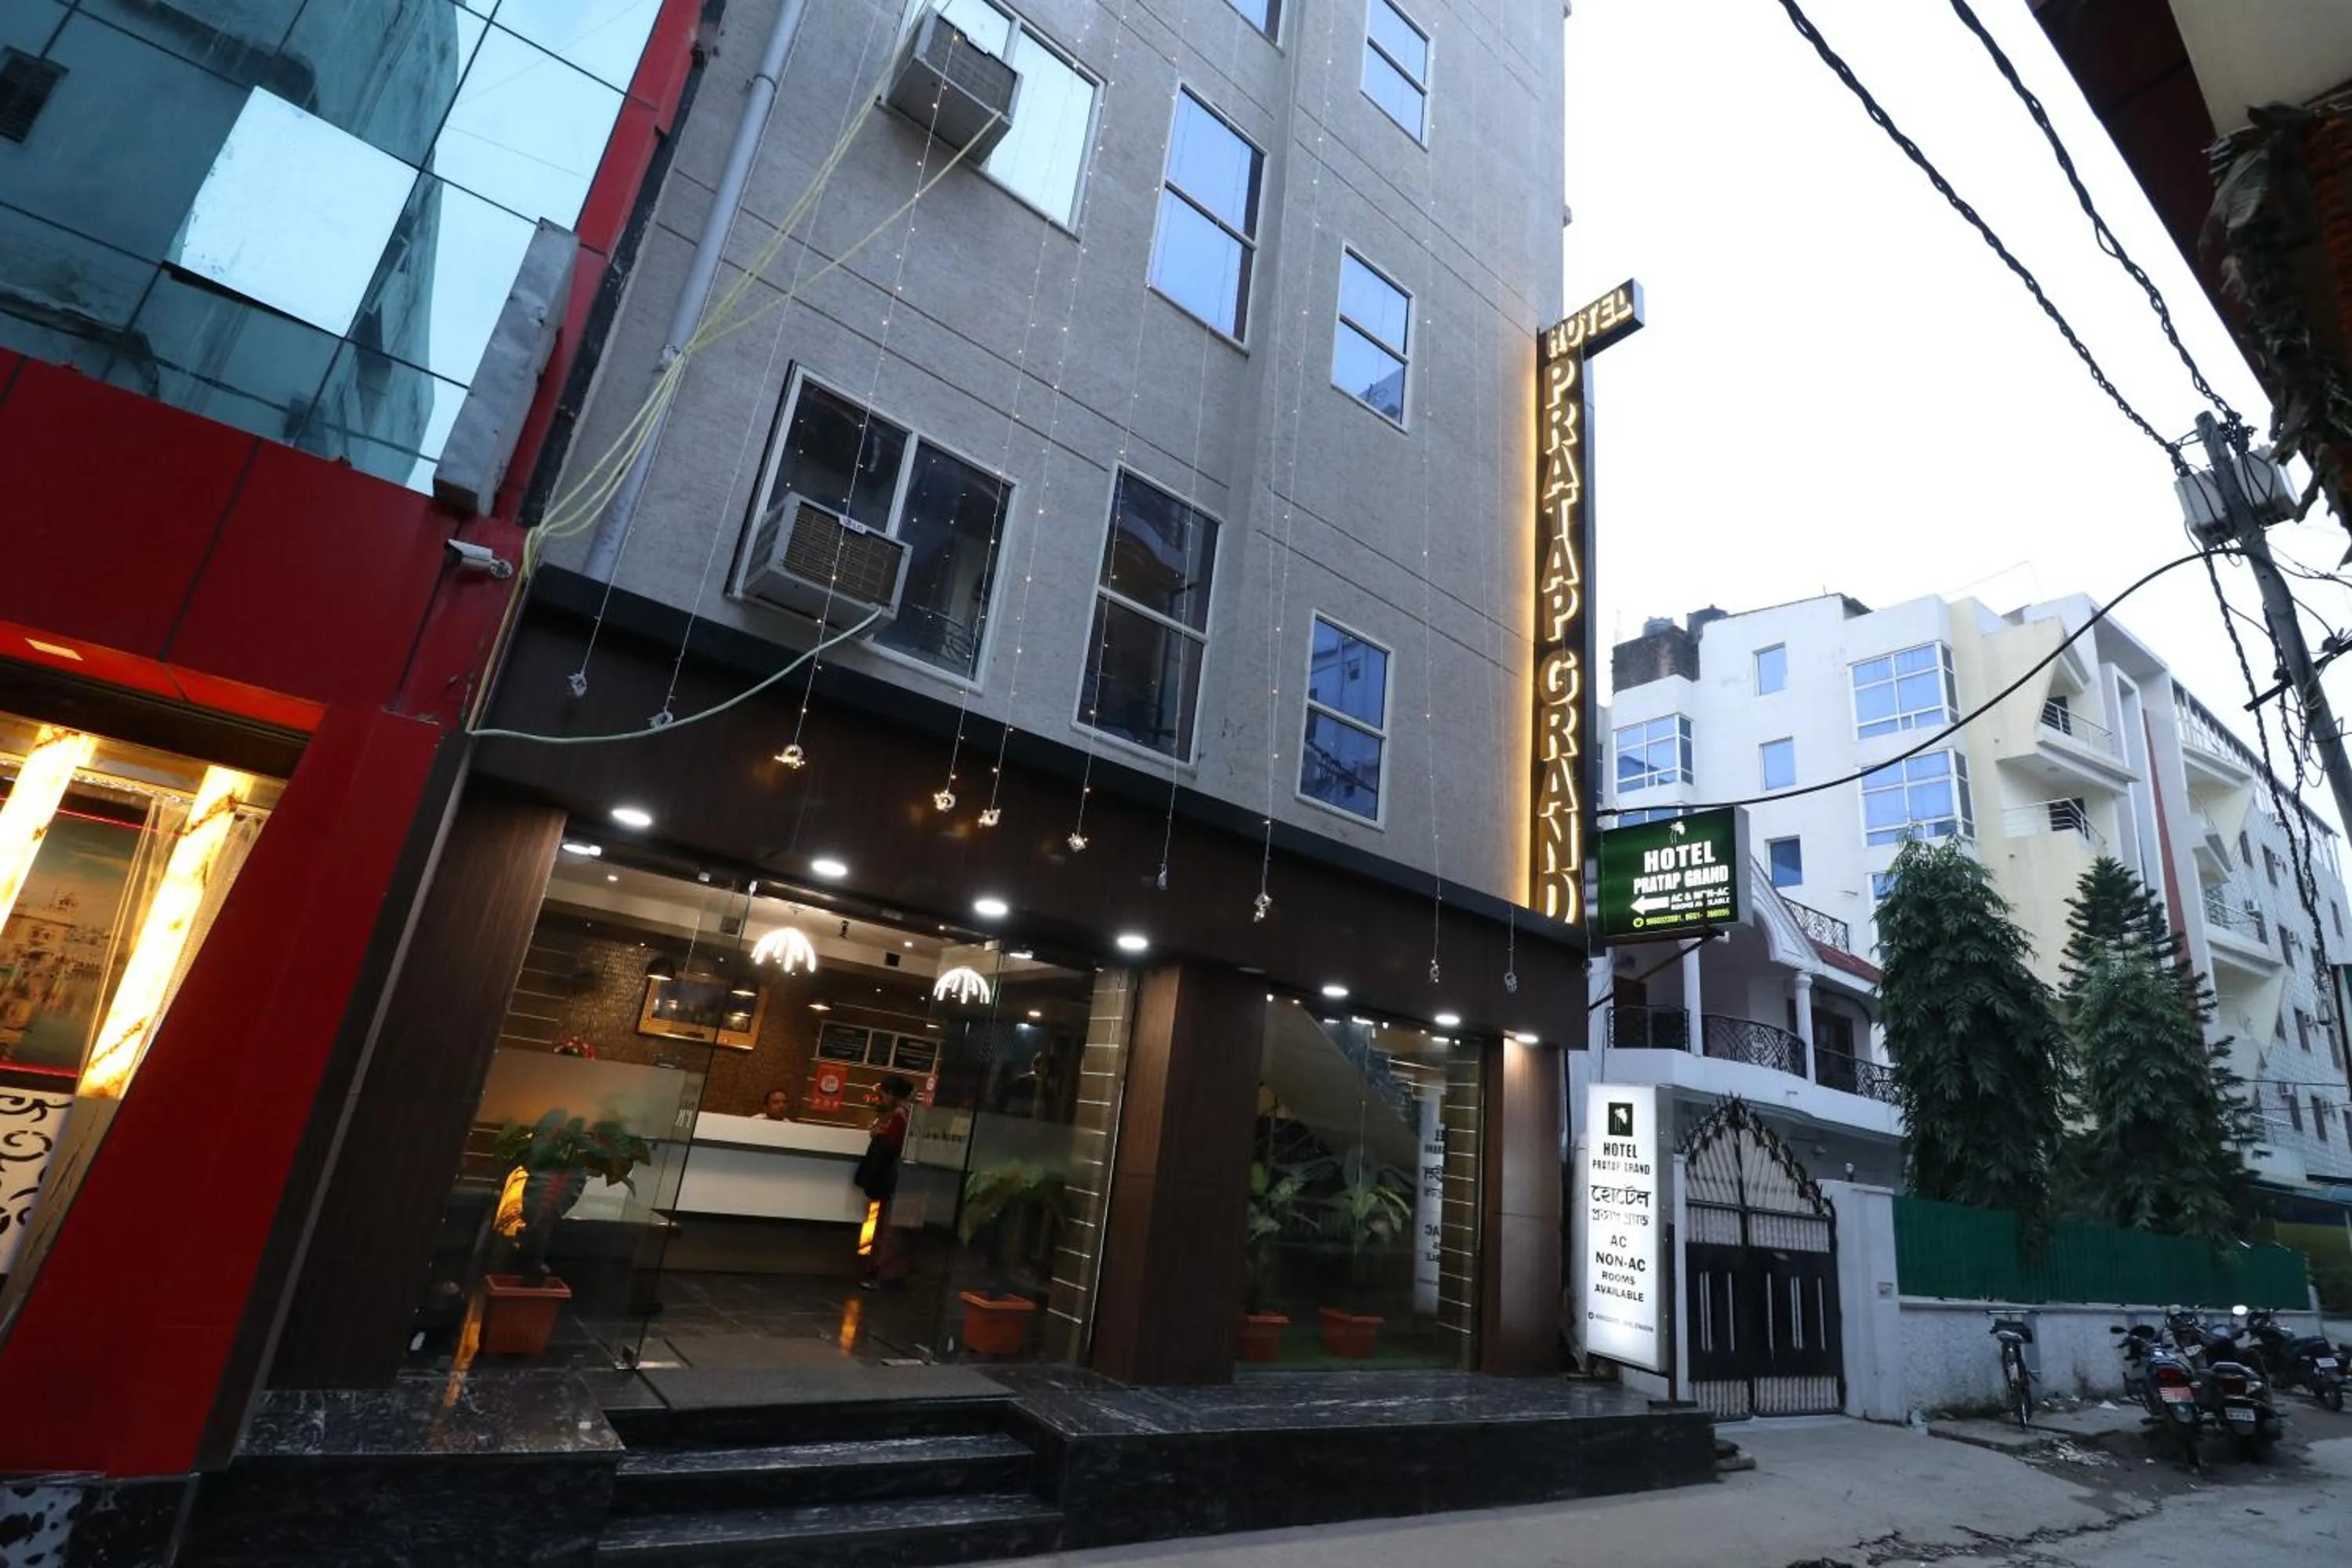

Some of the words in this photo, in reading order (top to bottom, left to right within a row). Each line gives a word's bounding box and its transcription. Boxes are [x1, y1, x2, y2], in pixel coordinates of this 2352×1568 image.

[1546, 289, 1633, 359] HOTEL
[1541, 360, 1579, 641] PRATAP
[1537, 650, 1579, 924] GRAND
[1644, 840, 1715, 873] HOTEL
[1634, 872, 1682, 895] PRATAP
[1684, 865, 1729, 887] GRAND
[1671, 893, 1682, 902] AC
[1603, 1142, 1638, 1159] HOTEL
[1610, 1234, 1627, 1248] AC
[1595, 1250, 1646, 1272] NON-AC
[1602, 1270, 1635, 1286] ROOMS
[1595, 1283, 1644, 1301] AVAILABLE
